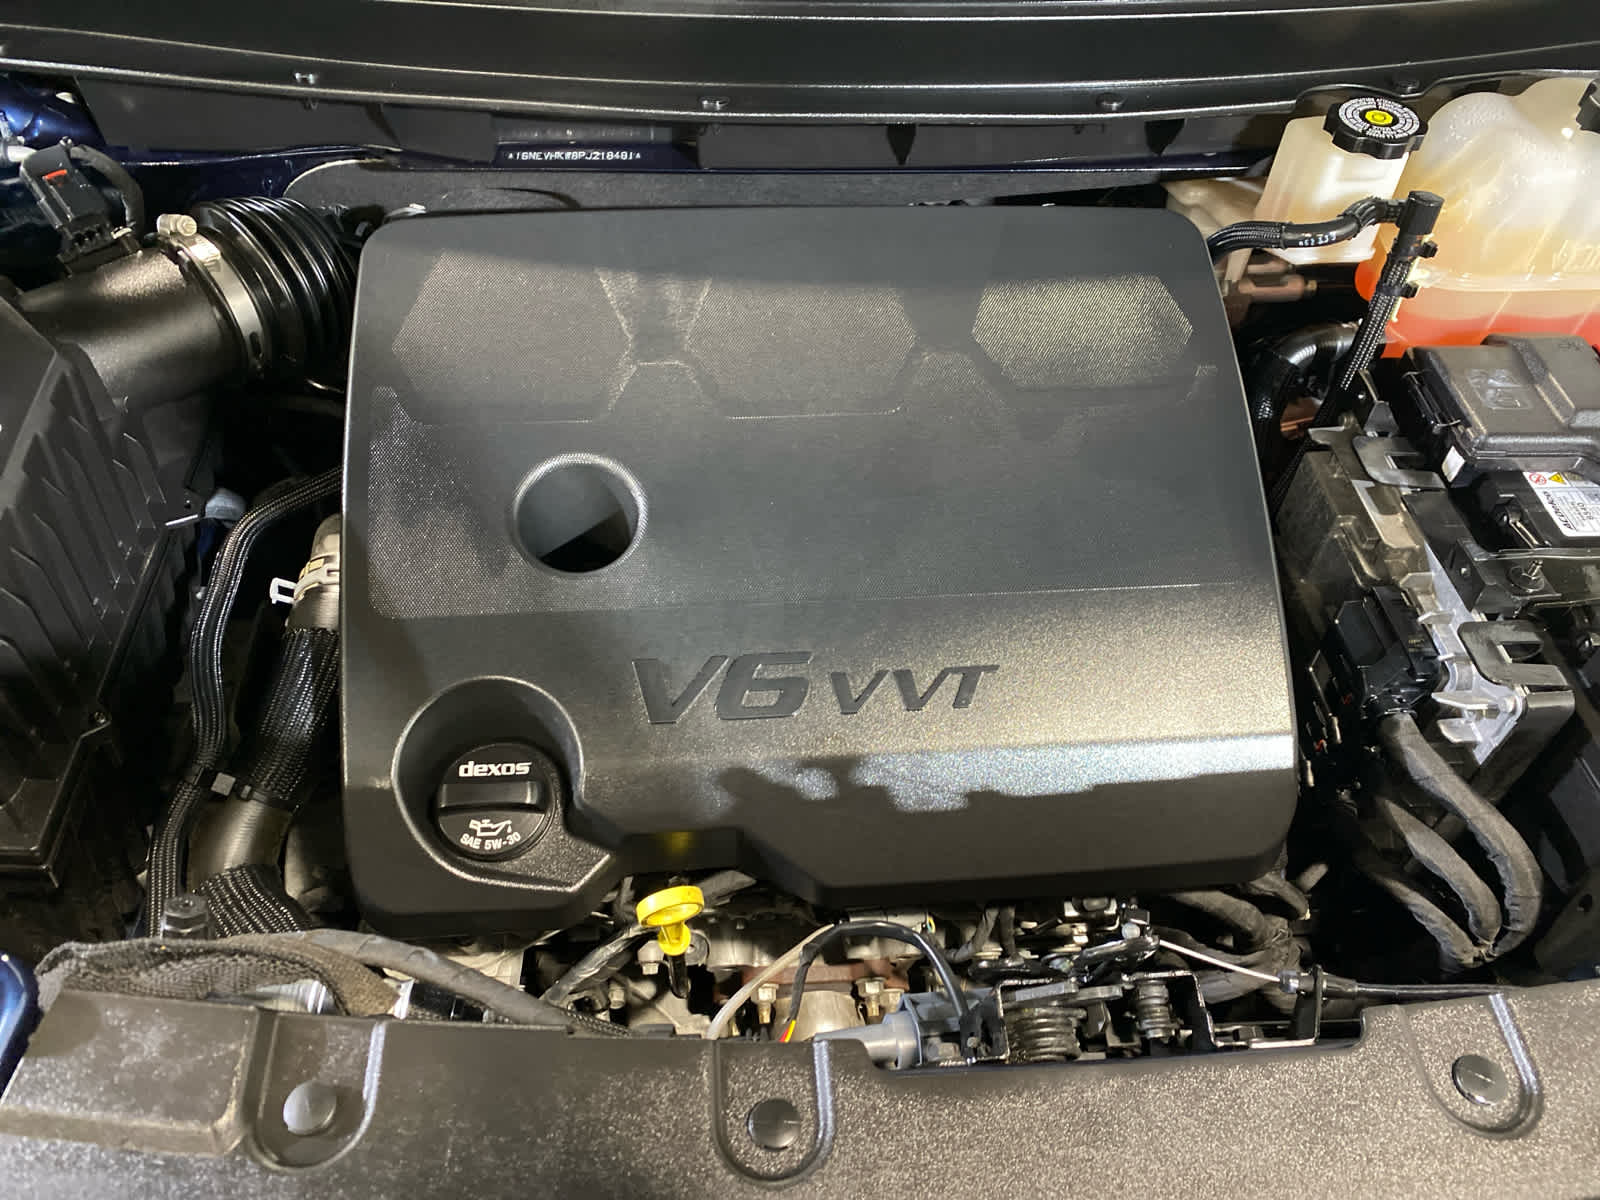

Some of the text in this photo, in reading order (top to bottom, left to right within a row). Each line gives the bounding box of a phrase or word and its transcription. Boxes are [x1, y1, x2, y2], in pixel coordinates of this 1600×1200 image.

[632, 651, 1000, 724] V6 VVT
[459, 761, 532, 777] dexos
[460, 831, 521, 850] SAE 5W-30
